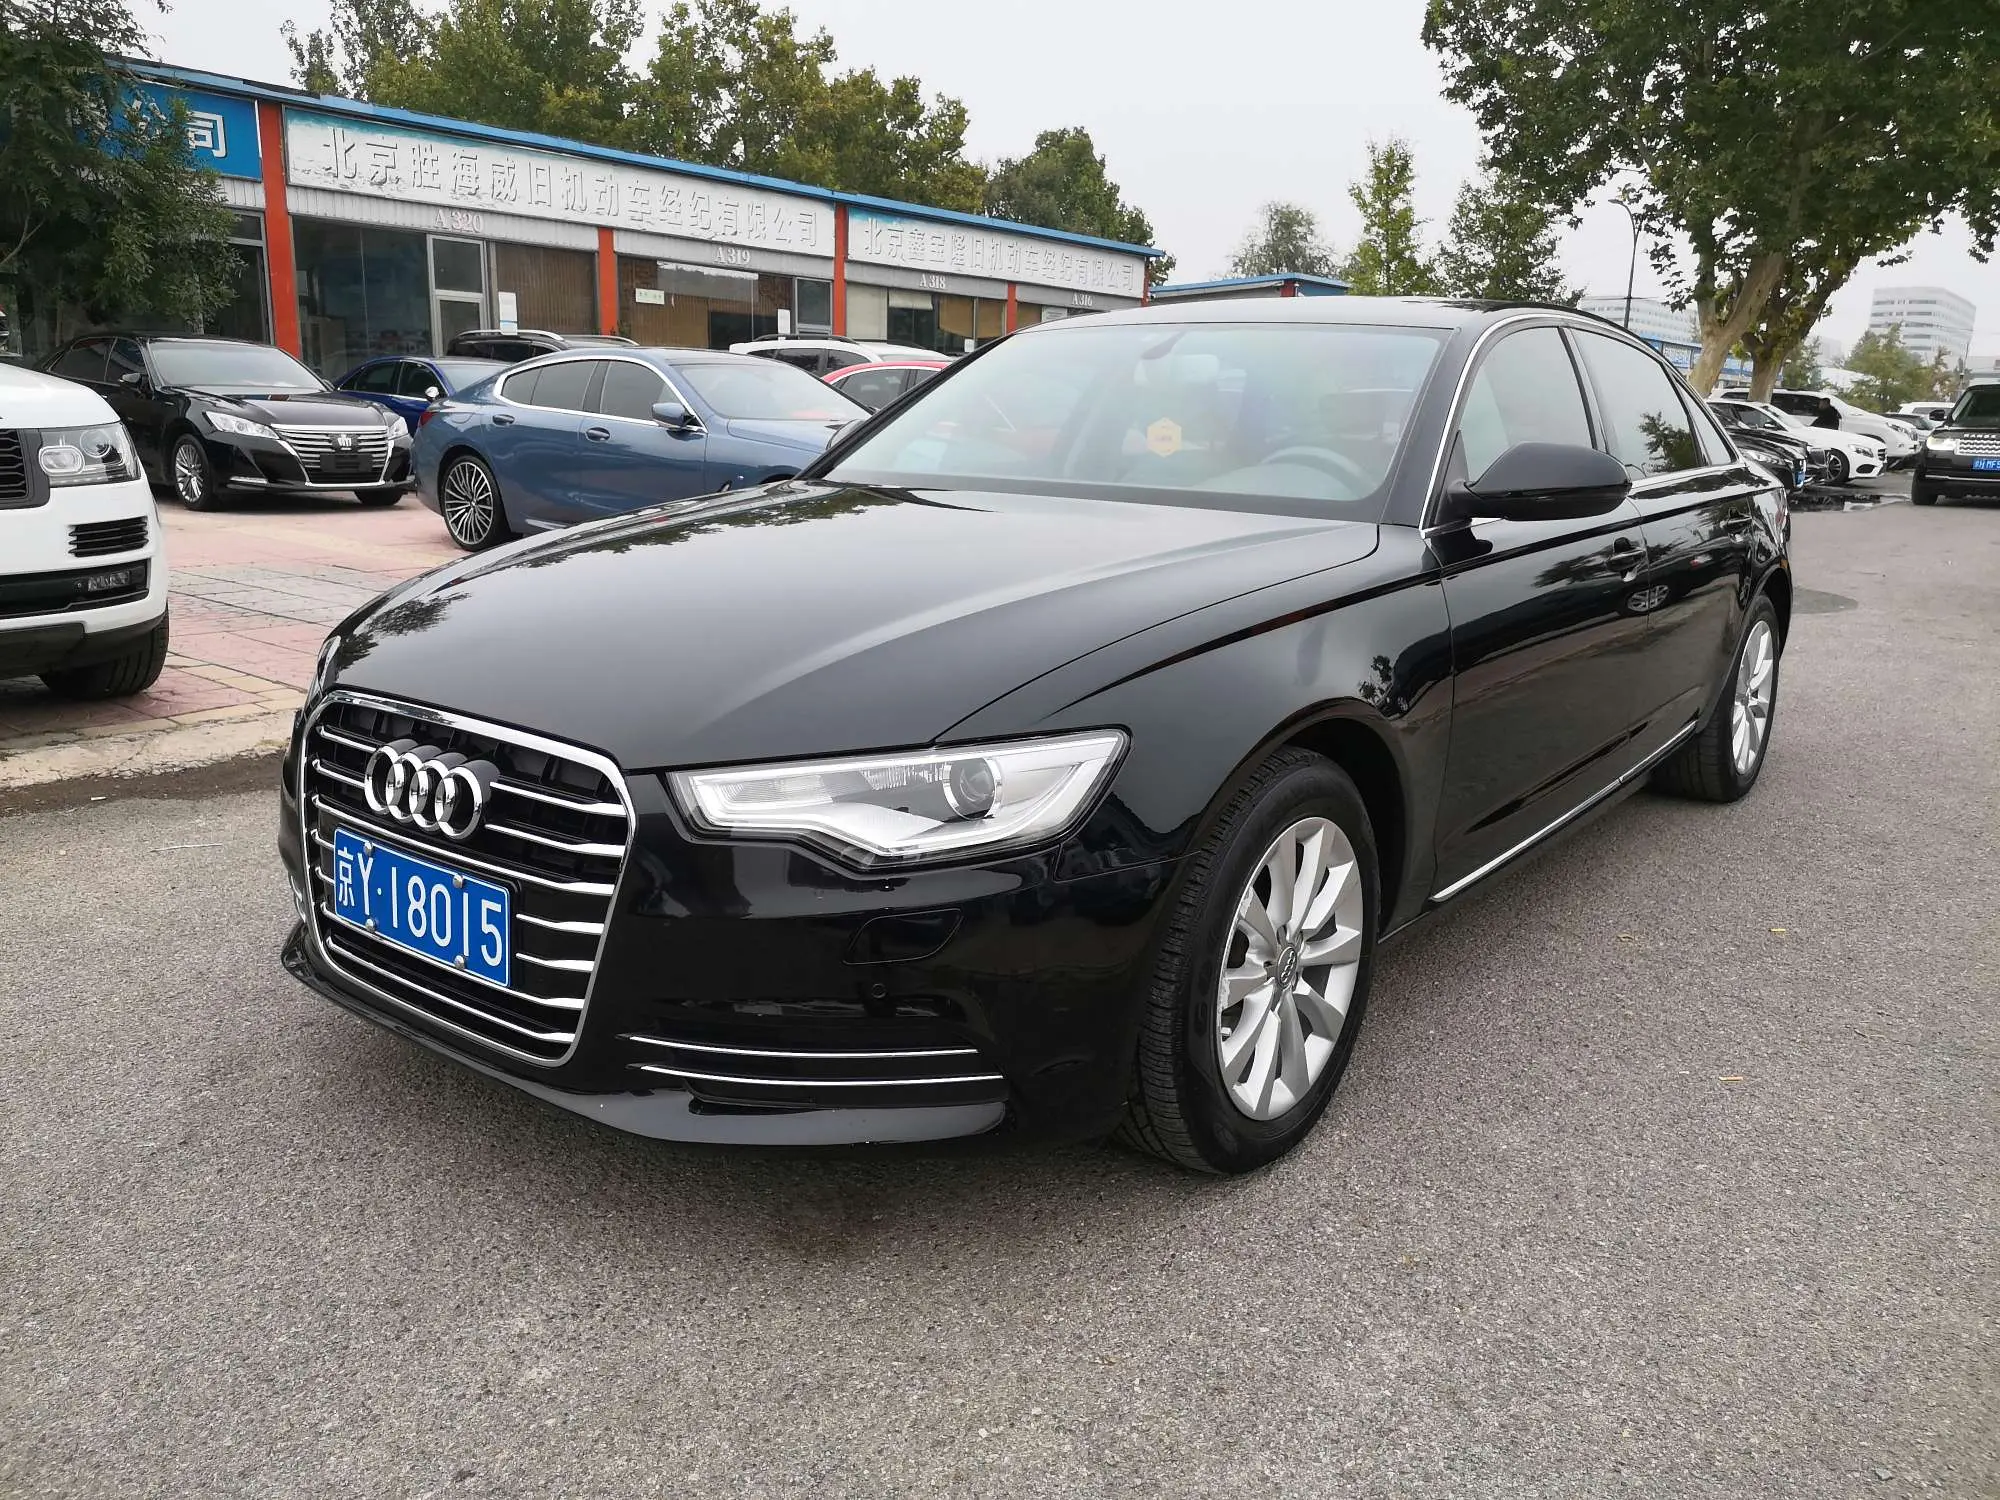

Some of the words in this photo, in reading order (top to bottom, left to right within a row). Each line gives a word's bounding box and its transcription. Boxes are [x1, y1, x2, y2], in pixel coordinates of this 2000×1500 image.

[713, 246, 750, 266] A319
[919, 273, 947, 290] A318
[337, 846, 503, 967] 京Y·18015
